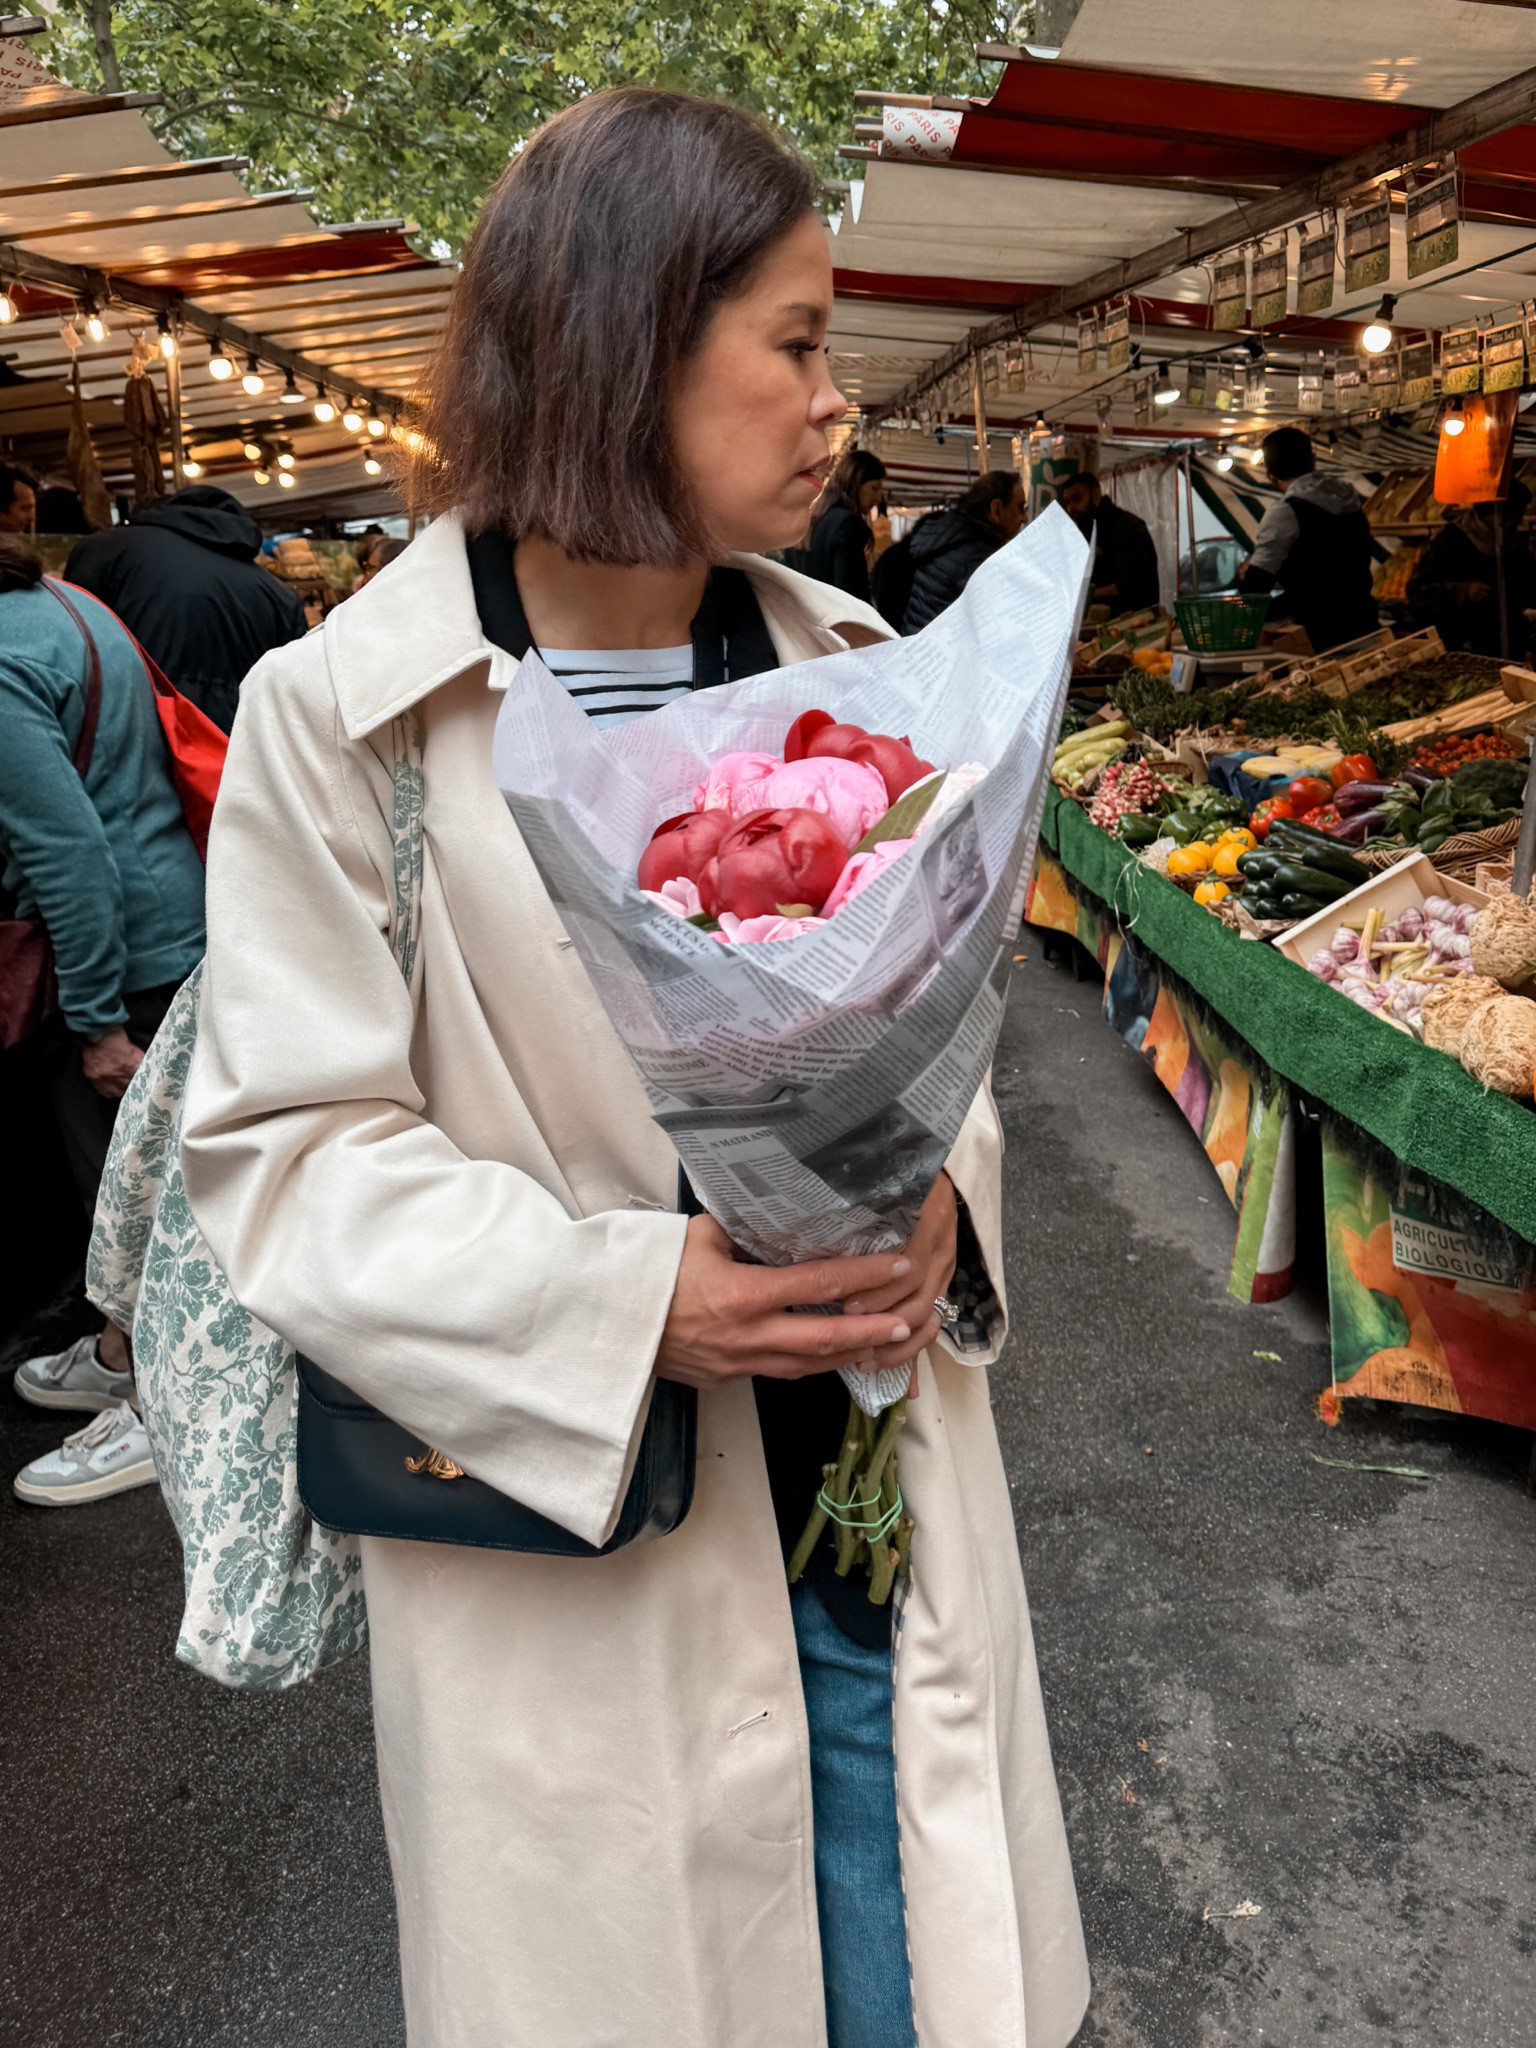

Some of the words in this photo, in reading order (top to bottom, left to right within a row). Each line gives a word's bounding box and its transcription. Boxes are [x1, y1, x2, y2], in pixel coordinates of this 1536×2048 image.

[907, 111, 941, 144] PARIS
[649, 918, 697, 957] SCIENCE
[659, 912, 701, 943] FOCUS
[719, 1134, 751, 1148] MATH
[751, 1128, 774, 1142] AND
[1395, 1241, 1503, 1281] BIOLOGIQU
